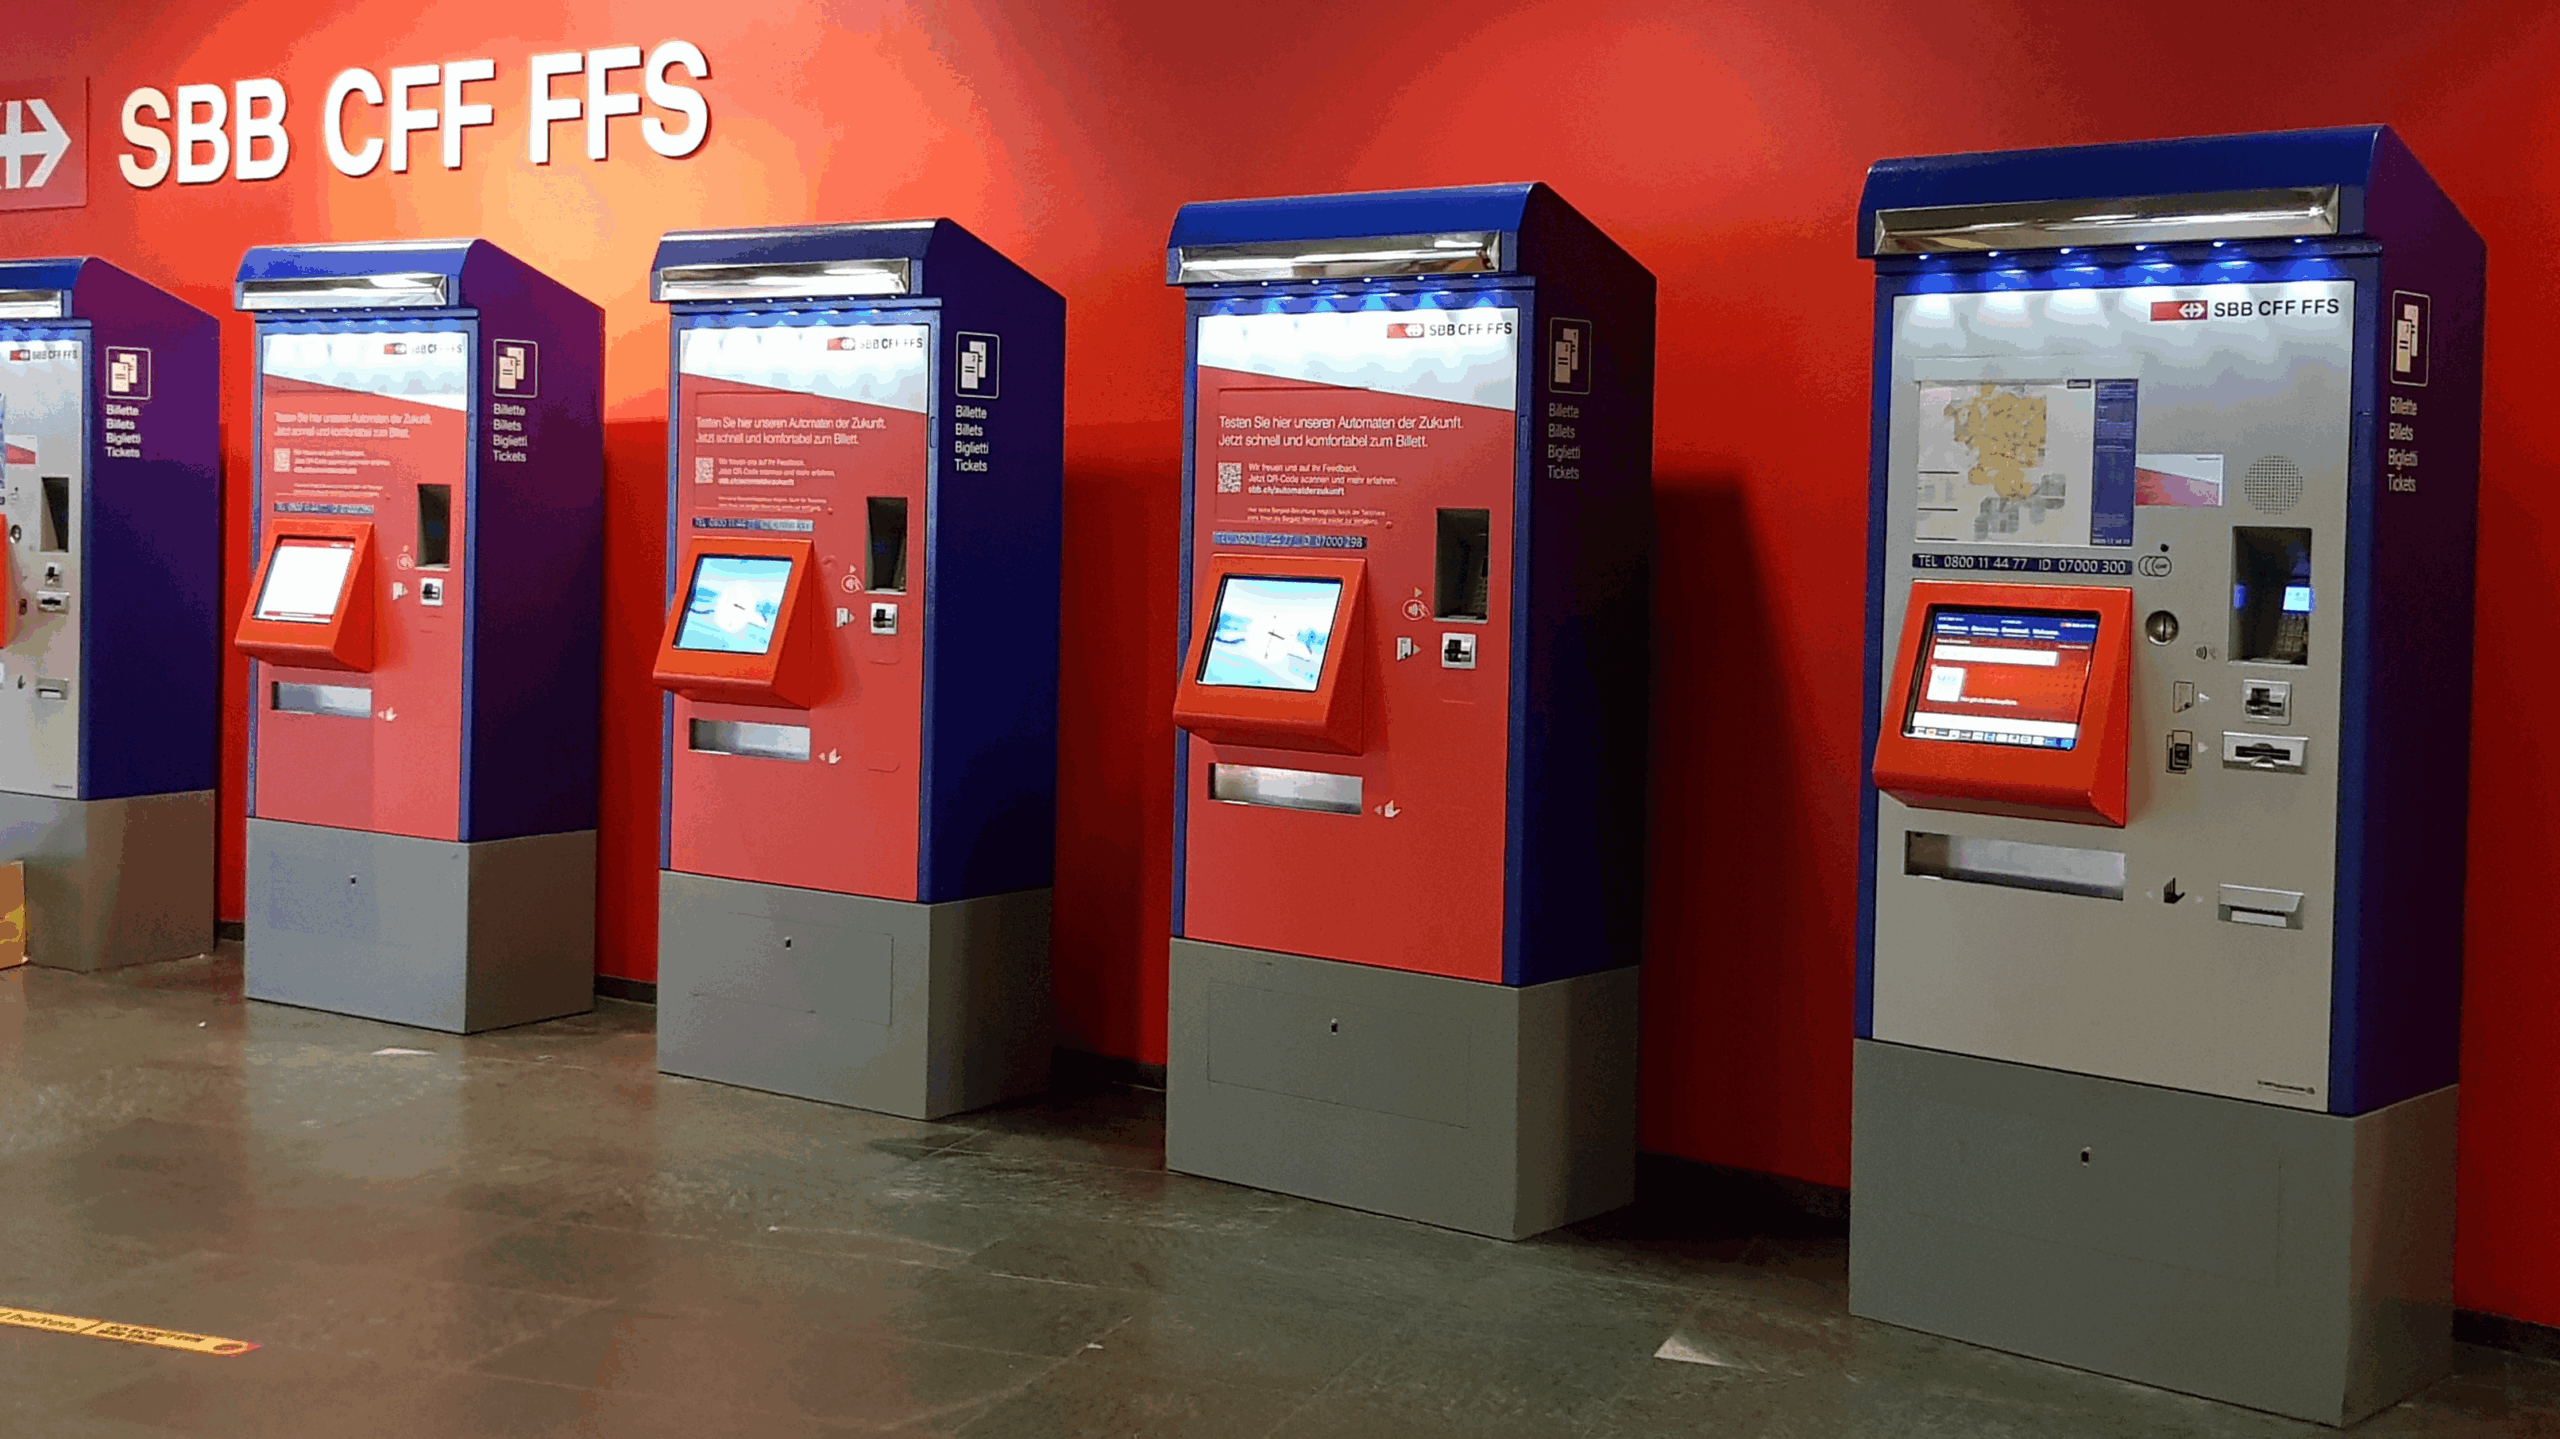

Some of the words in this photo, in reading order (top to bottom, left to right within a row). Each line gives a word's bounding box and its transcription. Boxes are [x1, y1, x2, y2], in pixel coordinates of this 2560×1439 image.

[118, 78, 291, 188] SBB
[324, 59, 495, 176] CFF
[530, 40, 709, 164] FFS
[2214, 301, 2253, 317] SBB
[2258, 300, 2296, 316] CFF
[2302, 299, 2339, 314] FFS
[1429, 324, 1455, 336] SBB
[1458, 323, 1483, 335] CFF
[1487, 322, 1512, 335] FFS
[106, 404, 139, 416] Billette
[493, 403, 526, 416] Billette
[955, 405, 987, 419] Billette
[1549, 402, 1579, 418] Billette
[2390, 396, 2417, 416] Billette
[106, 418, 135, 430] Billets
[493, 418, 522, 431] Billets
[955, 422, 983, 436] Billets
[1219, 415, 1252, 428] Testen
[1254, 415, 1271, 429] Sie
[1272, 416, 1292, 428] hier
[1294, 417, 1335, 429] unseren
[1337, 416, 1395, 429] Automaten
[1397, 416, 1417, 429] der
[1419, 415, 1464, 429] Zukunft.
[1548, 423, 1575, 439] Billets
[2389, 422, 2413, 441] Billets
[106, 433, 141, 446] Biglietti
[493, 434, 528, 448] Biglietti
[1218, 434, 1243, 446] Jetzt
[1245, 434, 1281, 447] schnell
[1283, 434, 1303, 447] und
[1305, 433, 1368, 447] komfortabel
[1370, 436, 1393, 447] zum
[1396, 434, 1428, 447] Billett.
[105, 447, 140, 458] Tickets
[493, 450, 526, 462] Tickets
[955, 441, 989, 457] Biglietti
[1548, 444, 1580, 462] Biglietti
[954, 458, 988, 471] Tickets
[2388, 448, 2418, 470] Biglietti
[1547, 465, 1579, 480] Tickets
[2387, 473, 2416, 492] Tickets
[1316, 536, 1343, 547] 07000
[1344, 537, 1363, 548] 298
[1918, 555, 1937, 567] TEL
[1944, 555, 1973, 568] 0800
[1978, 556, 1988, 568] 11
[1993, 557, 2009, 569] 44
[2012, 557, 2027, 570] 77
[2038, 558, 2050, 571] ID
[2058, 559, 2098, 572] 07000
[2102, 560, 2126, 573] 300
